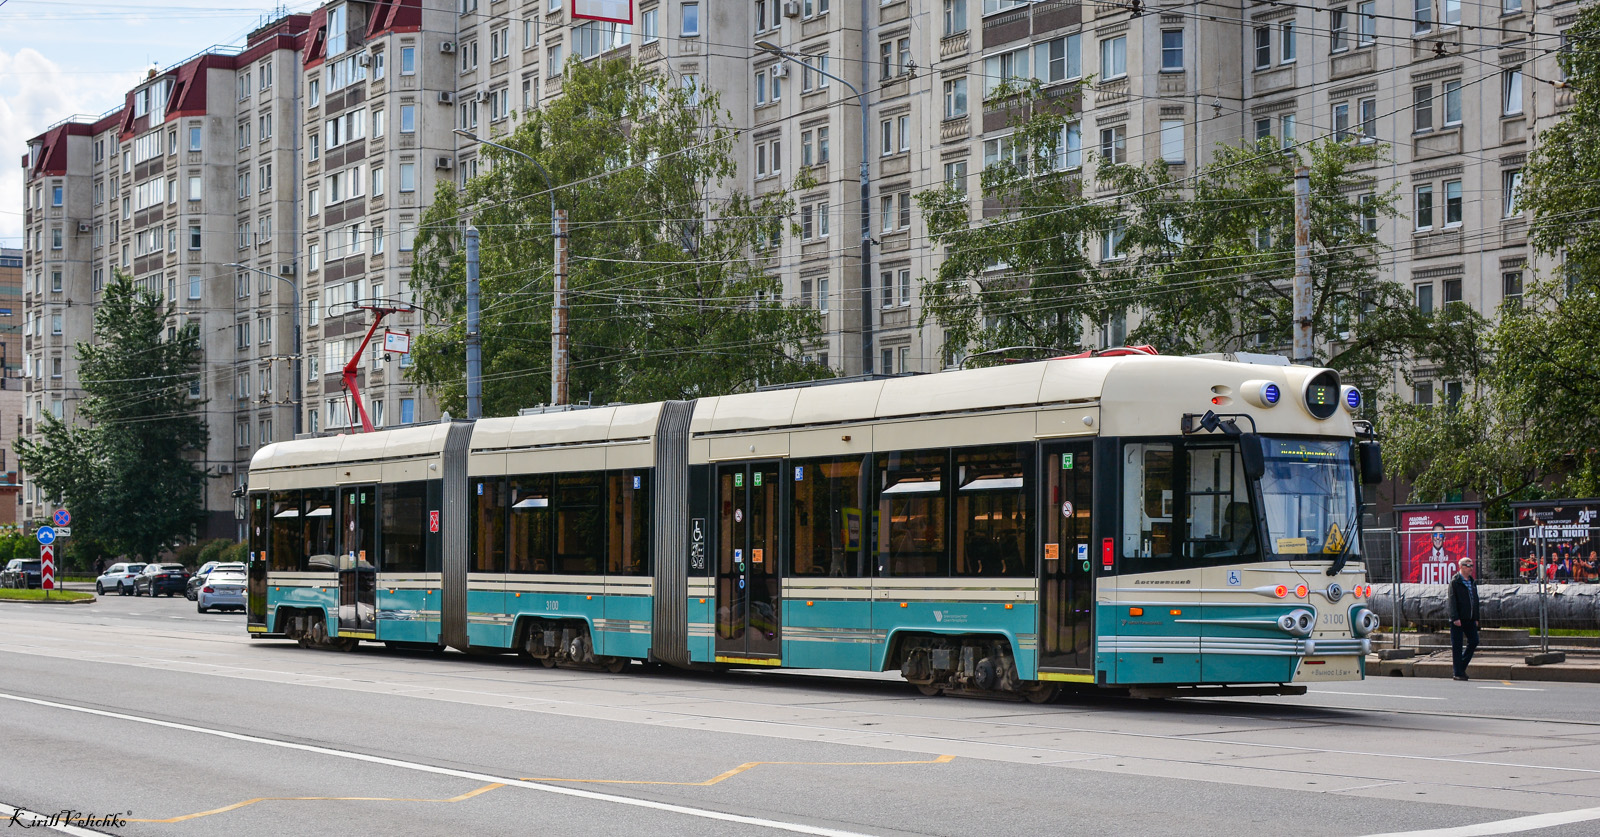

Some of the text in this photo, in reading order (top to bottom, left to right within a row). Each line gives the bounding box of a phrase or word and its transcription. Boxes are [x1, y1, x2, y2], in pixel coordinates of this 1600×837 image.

[1454, 515, 1469, 525] 15.07
[1579, 511, 1590, 523] 24
[1562, 524, 1590, 537] NIGHT
[1420, 563, 1456, 584] ЛЕПС
[546, 600, 558, 610] 3100
[1323, 614, 1344, 625] 3100
